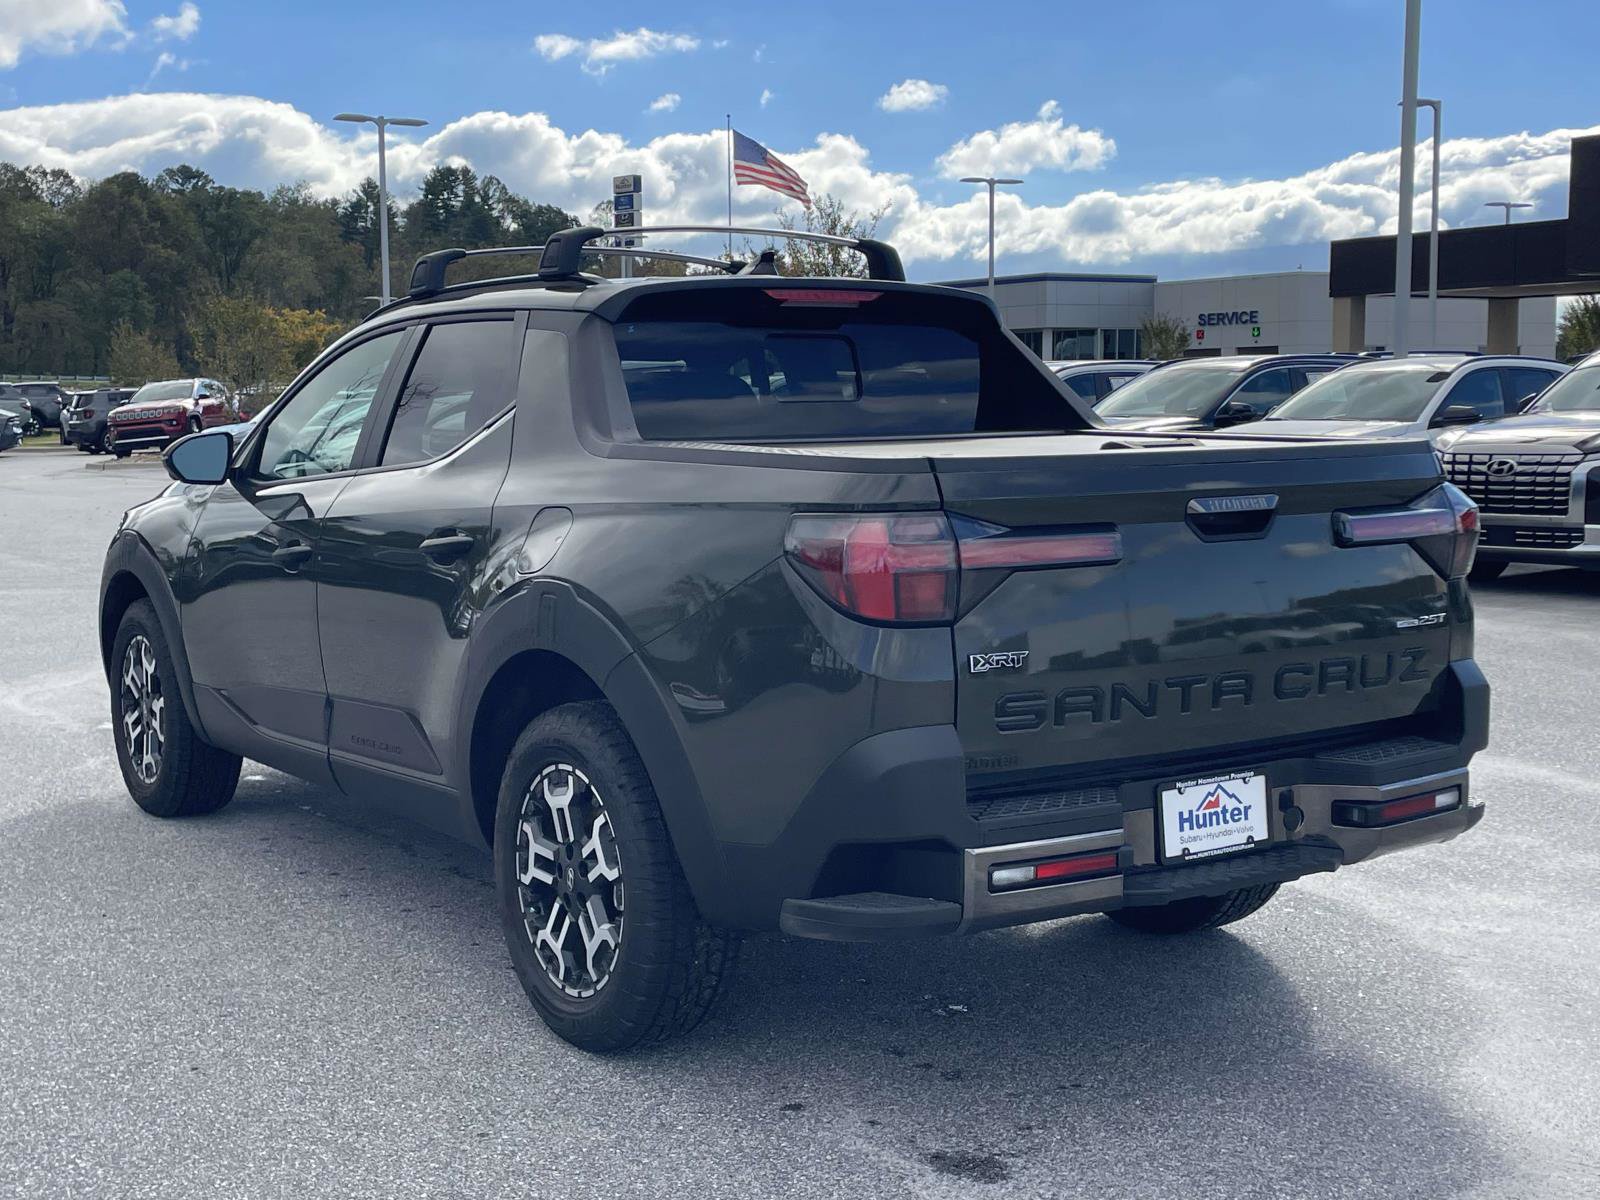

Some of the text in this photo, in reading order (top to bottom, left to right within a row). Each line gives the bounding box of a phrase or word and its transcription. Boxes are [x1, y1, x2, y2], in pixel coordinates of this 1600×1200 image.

[1198, 310, 1259, 327] SERVICE
[969, 650, 1030, 673] XRT
[994, 648, 1431, 735] SANTA CRUZ
[1176, 771, 1255, 789] Hunter Hometown Promise
[1178, 804, 1252, 833] Hunter
[1236, 825, 1255, 835] Volvo
